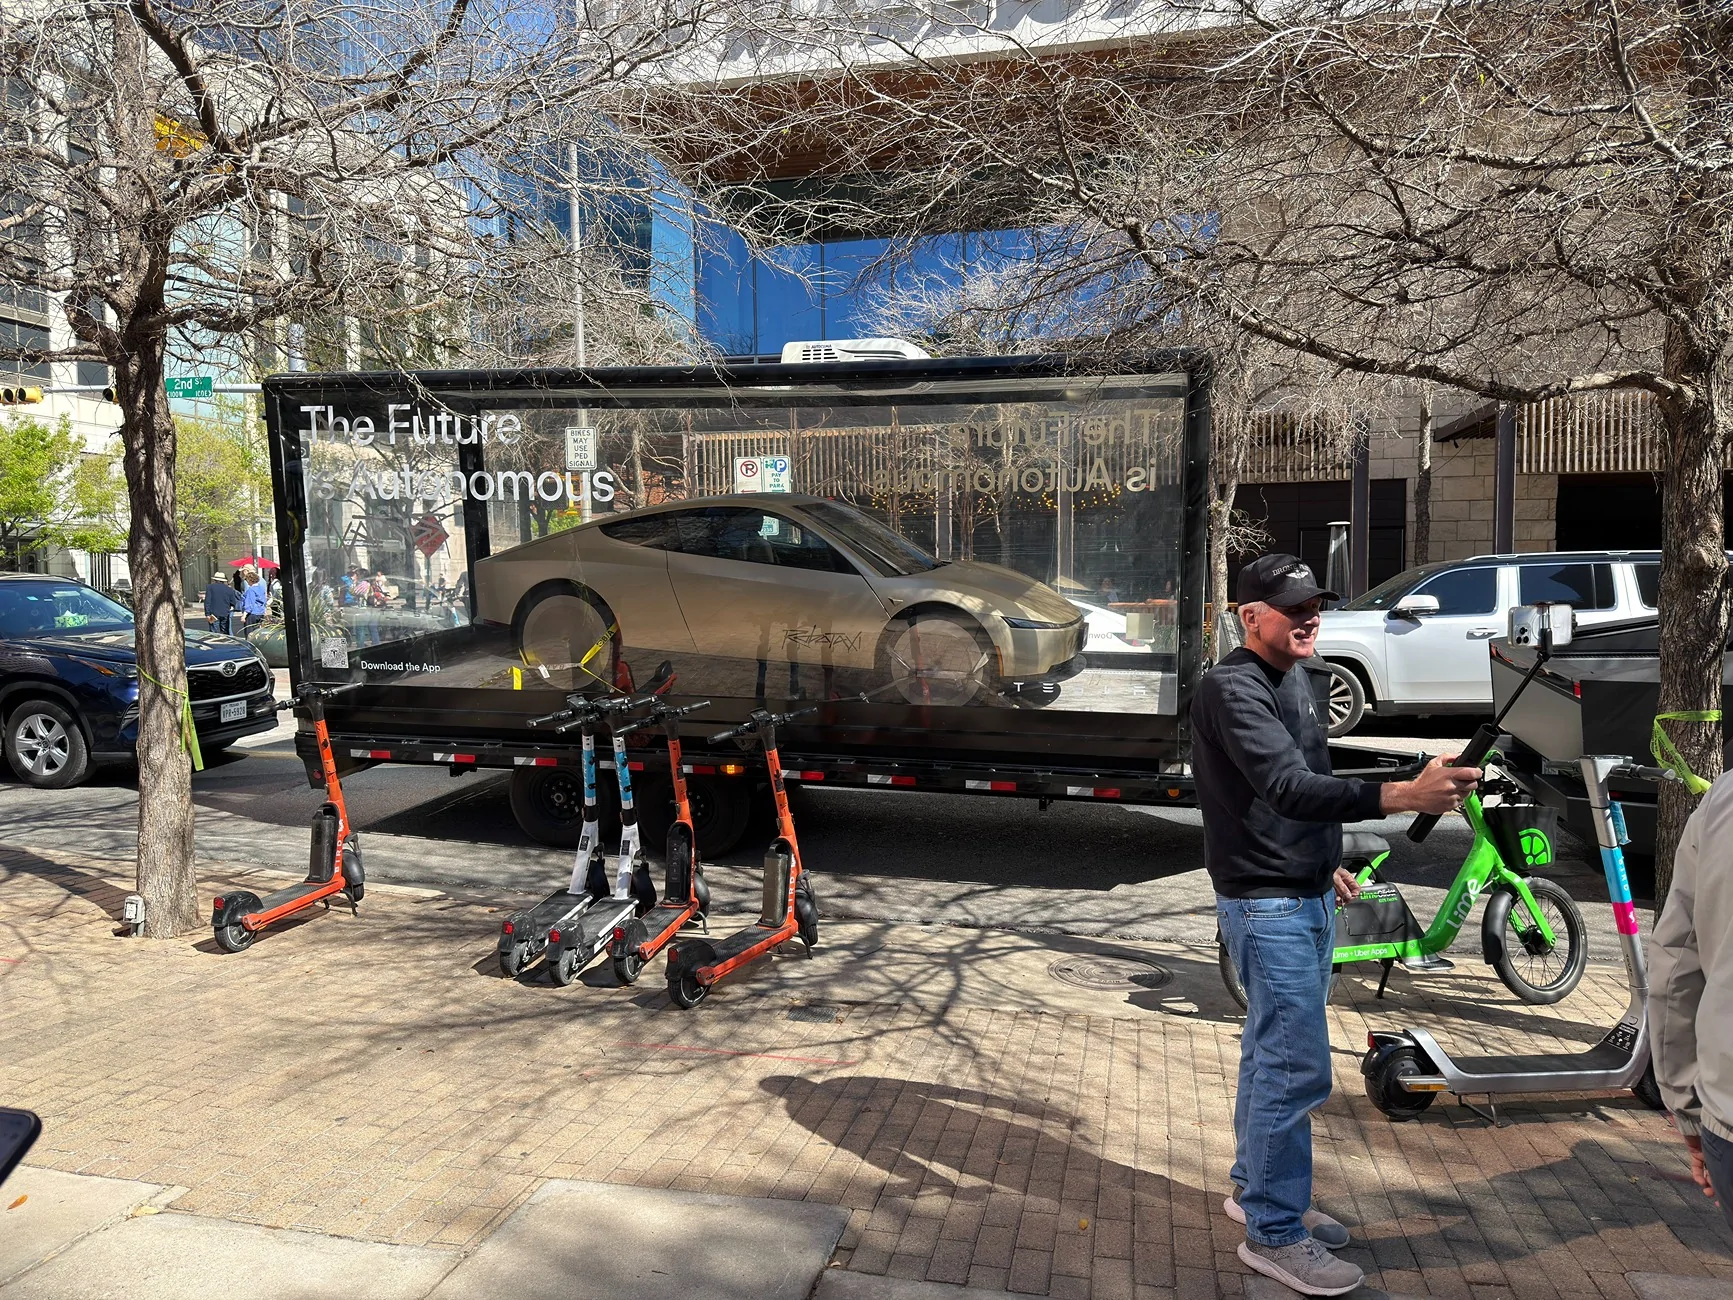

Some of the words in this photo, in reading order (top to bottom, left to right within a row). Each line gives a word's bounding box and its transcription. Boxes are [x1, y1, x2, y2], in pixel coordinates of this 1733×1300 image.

[174, 379, 193, 390] 2nd
[300, 404, 375, 445] The
[388, 403, 522, 446] Future
[346, 459, 616, 502] Autonomous
[361, 660, 404, 671] Download
[405, 662, 420, 672] the
[422, 662, 441, 674] App
[334, 839, 343, 873] BIRD
[787, 876, 796, 913] BIRD
[1446, 878, 1482, 929] Lime
[1333, 950, 1349, 959] Lime
[1354, 949, 1370, 957] Uber
[1371, 947, 1388, 956] Apps
